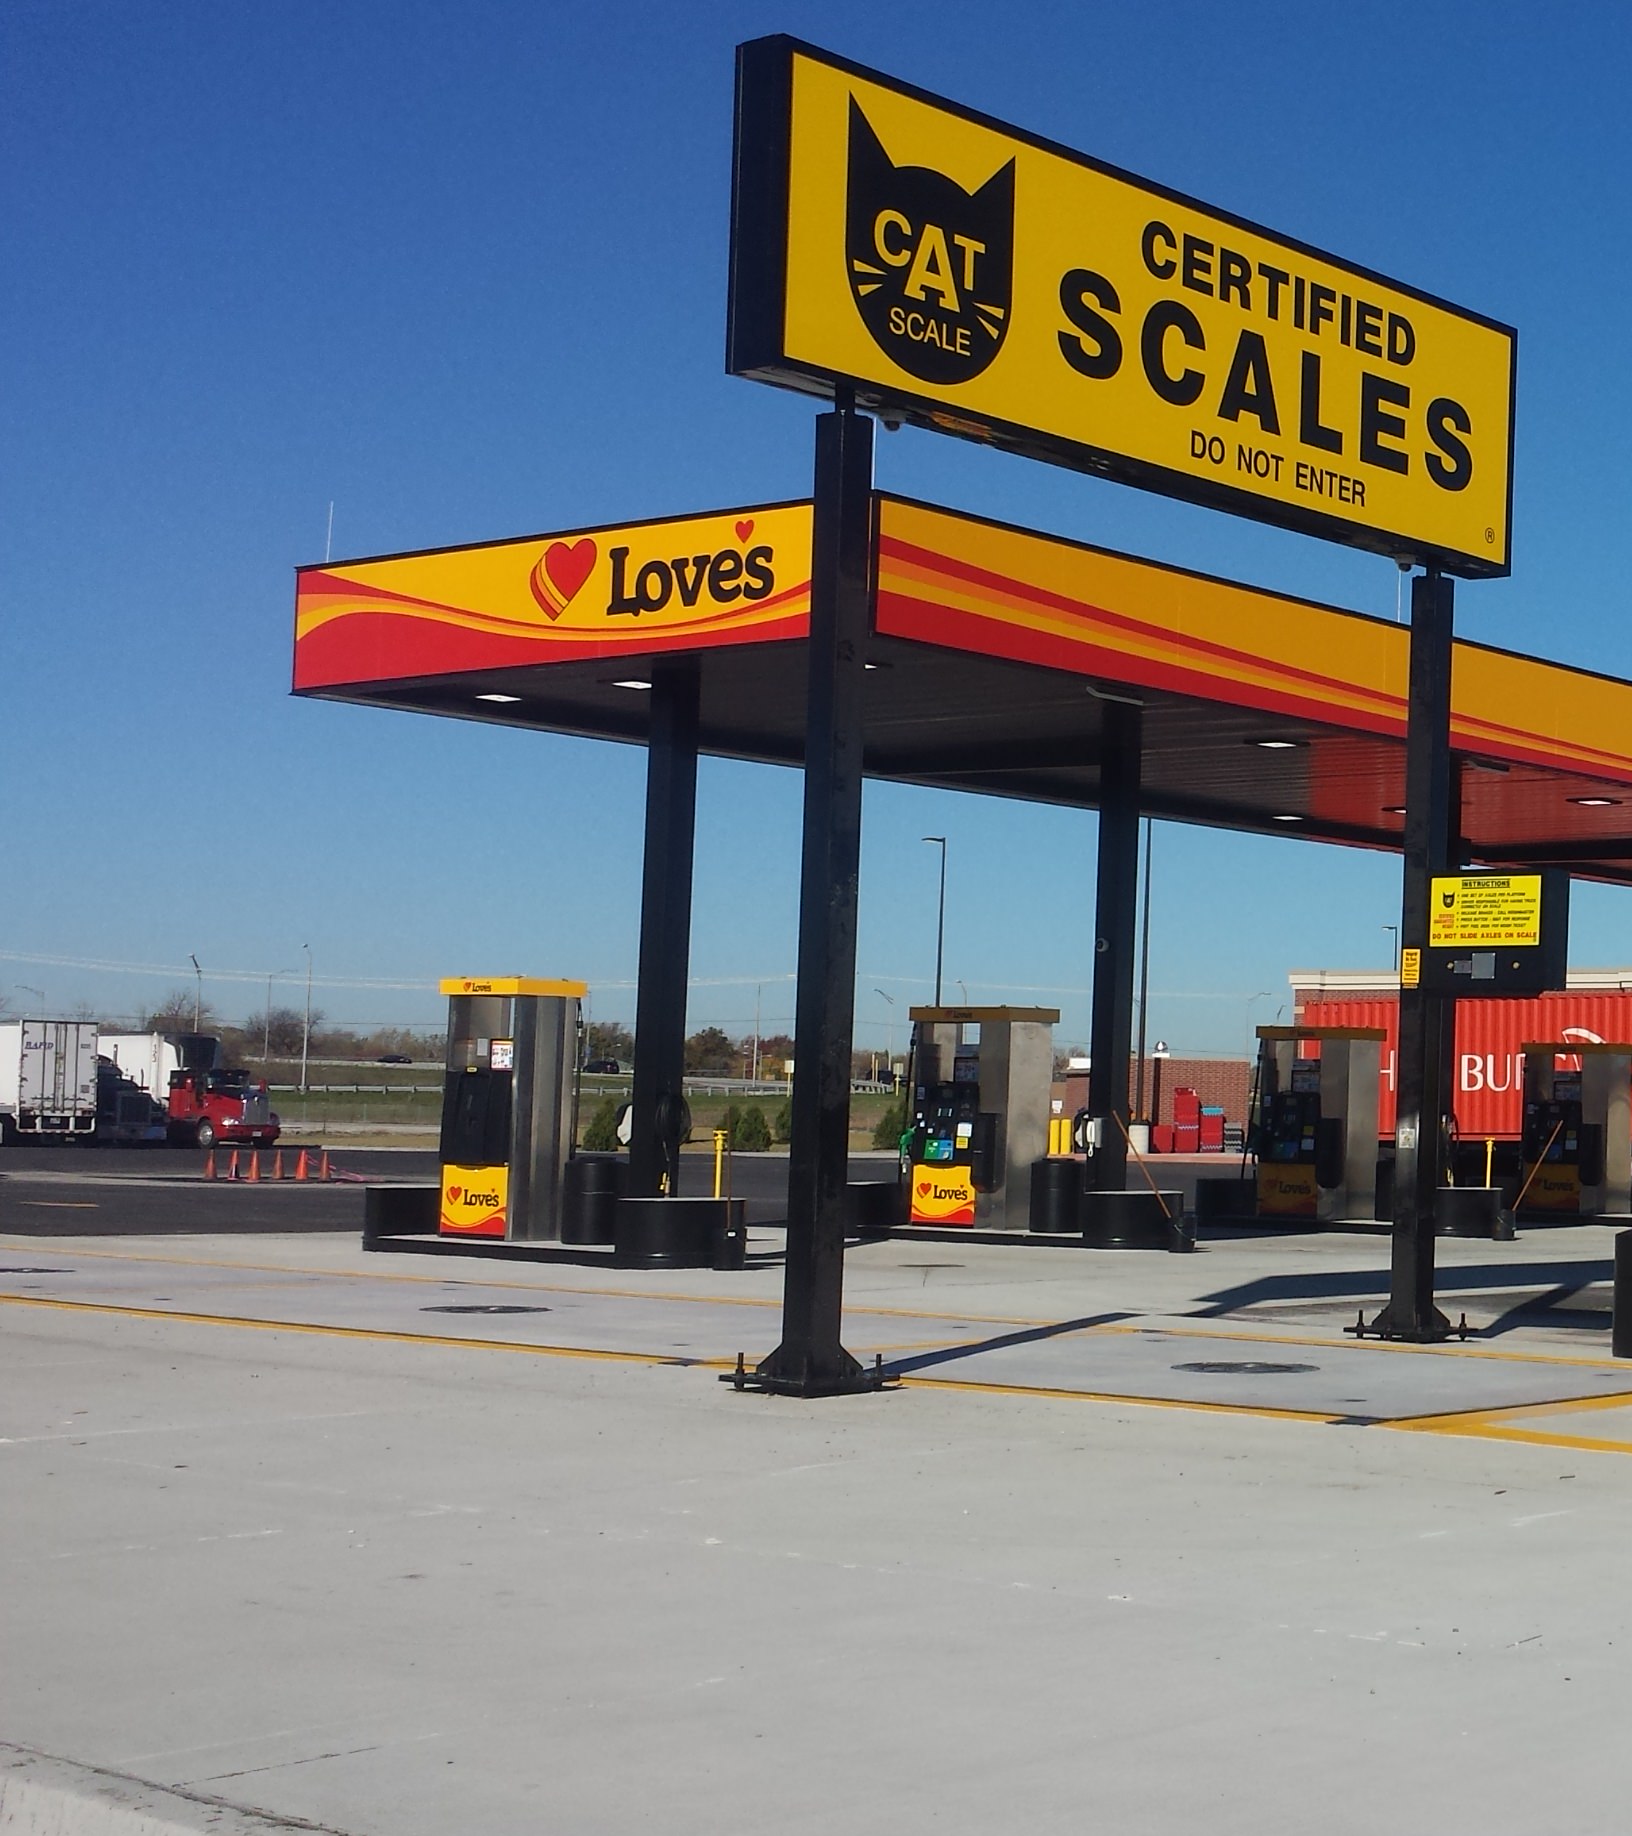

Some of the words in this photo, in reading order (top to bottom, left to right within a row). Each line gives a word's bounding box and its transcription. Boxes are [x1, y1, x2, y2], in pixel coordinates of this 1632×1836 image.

[873, 209, 986, 314] CAT
[1141, 220, 1417, 367] CERTIFIED
[889, 307, 972, 357] SCALE
[1057, 267, 1474, 493] SCALES
[1190, 430, 1226, 465] DO
[1237, 443, 1284, 483] NOT
[1295, 462, 1367, 508] ENTER
[606, 519, 775, 617] Love's
[1462, 880, 1510, 888] INSTRUCTIONS
[463, 1188, 500, 1207] Love's
[933, 1184, 968, 1200] Love's
